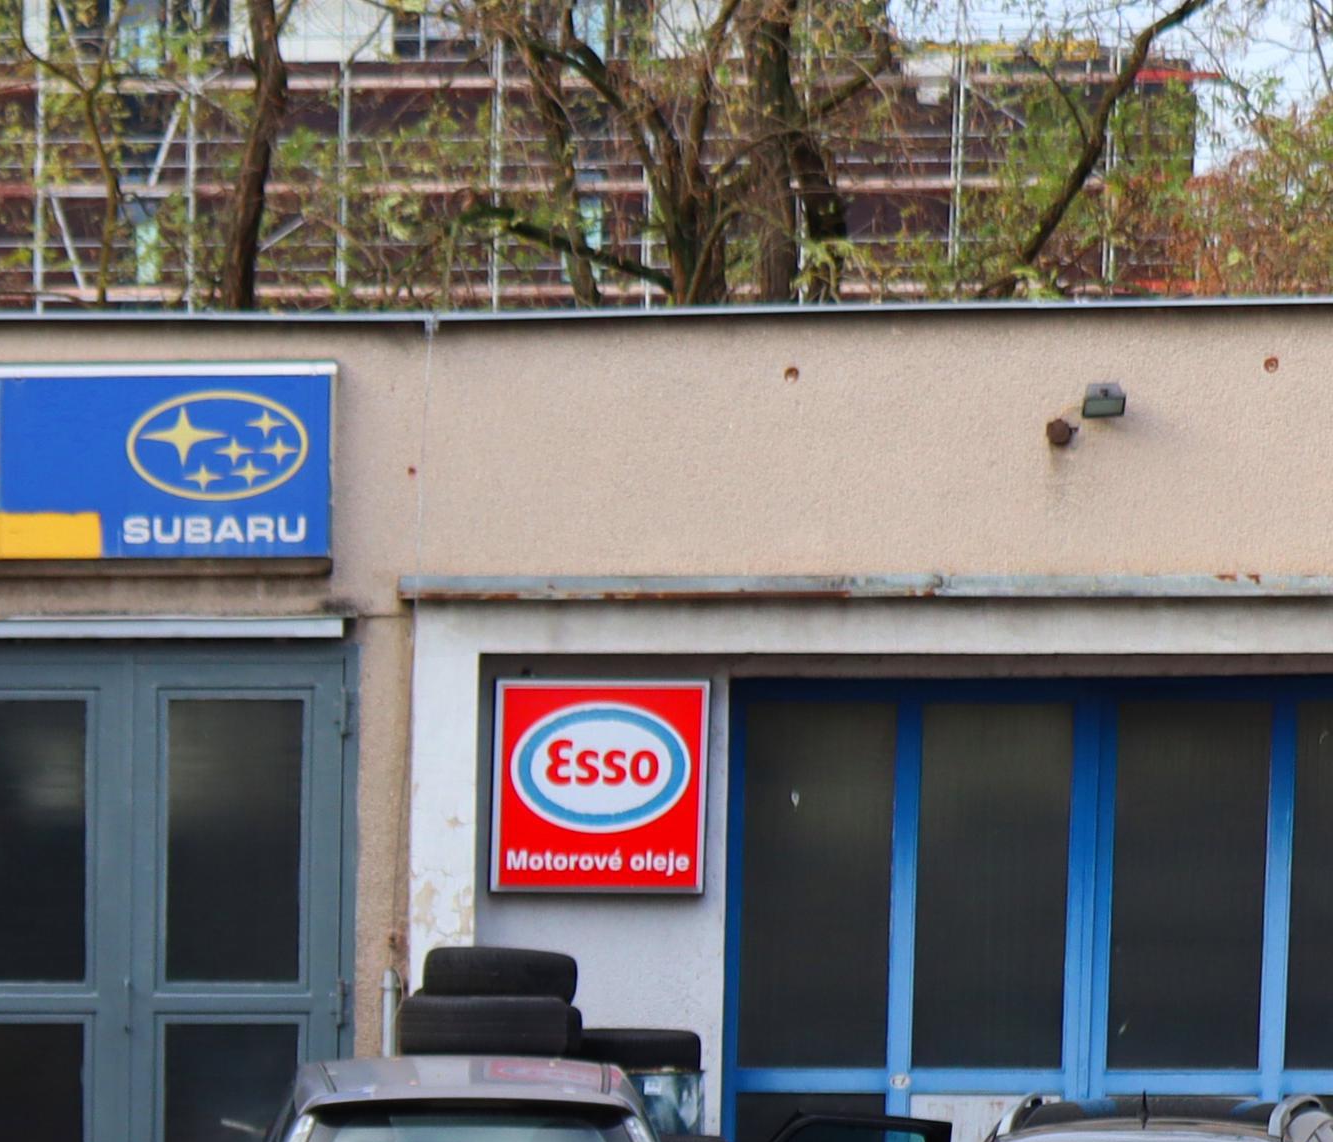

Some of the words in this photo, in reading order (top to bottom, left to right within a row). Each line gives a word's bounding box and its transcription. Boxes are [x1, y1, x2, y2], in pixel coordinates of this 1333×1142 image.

[123, 516, 307, 545] SUBARU
[545, 739, 660, 787] Esso
[506, 848, 622, 872] Motorové
[630, 851, 690, 877] oleje
